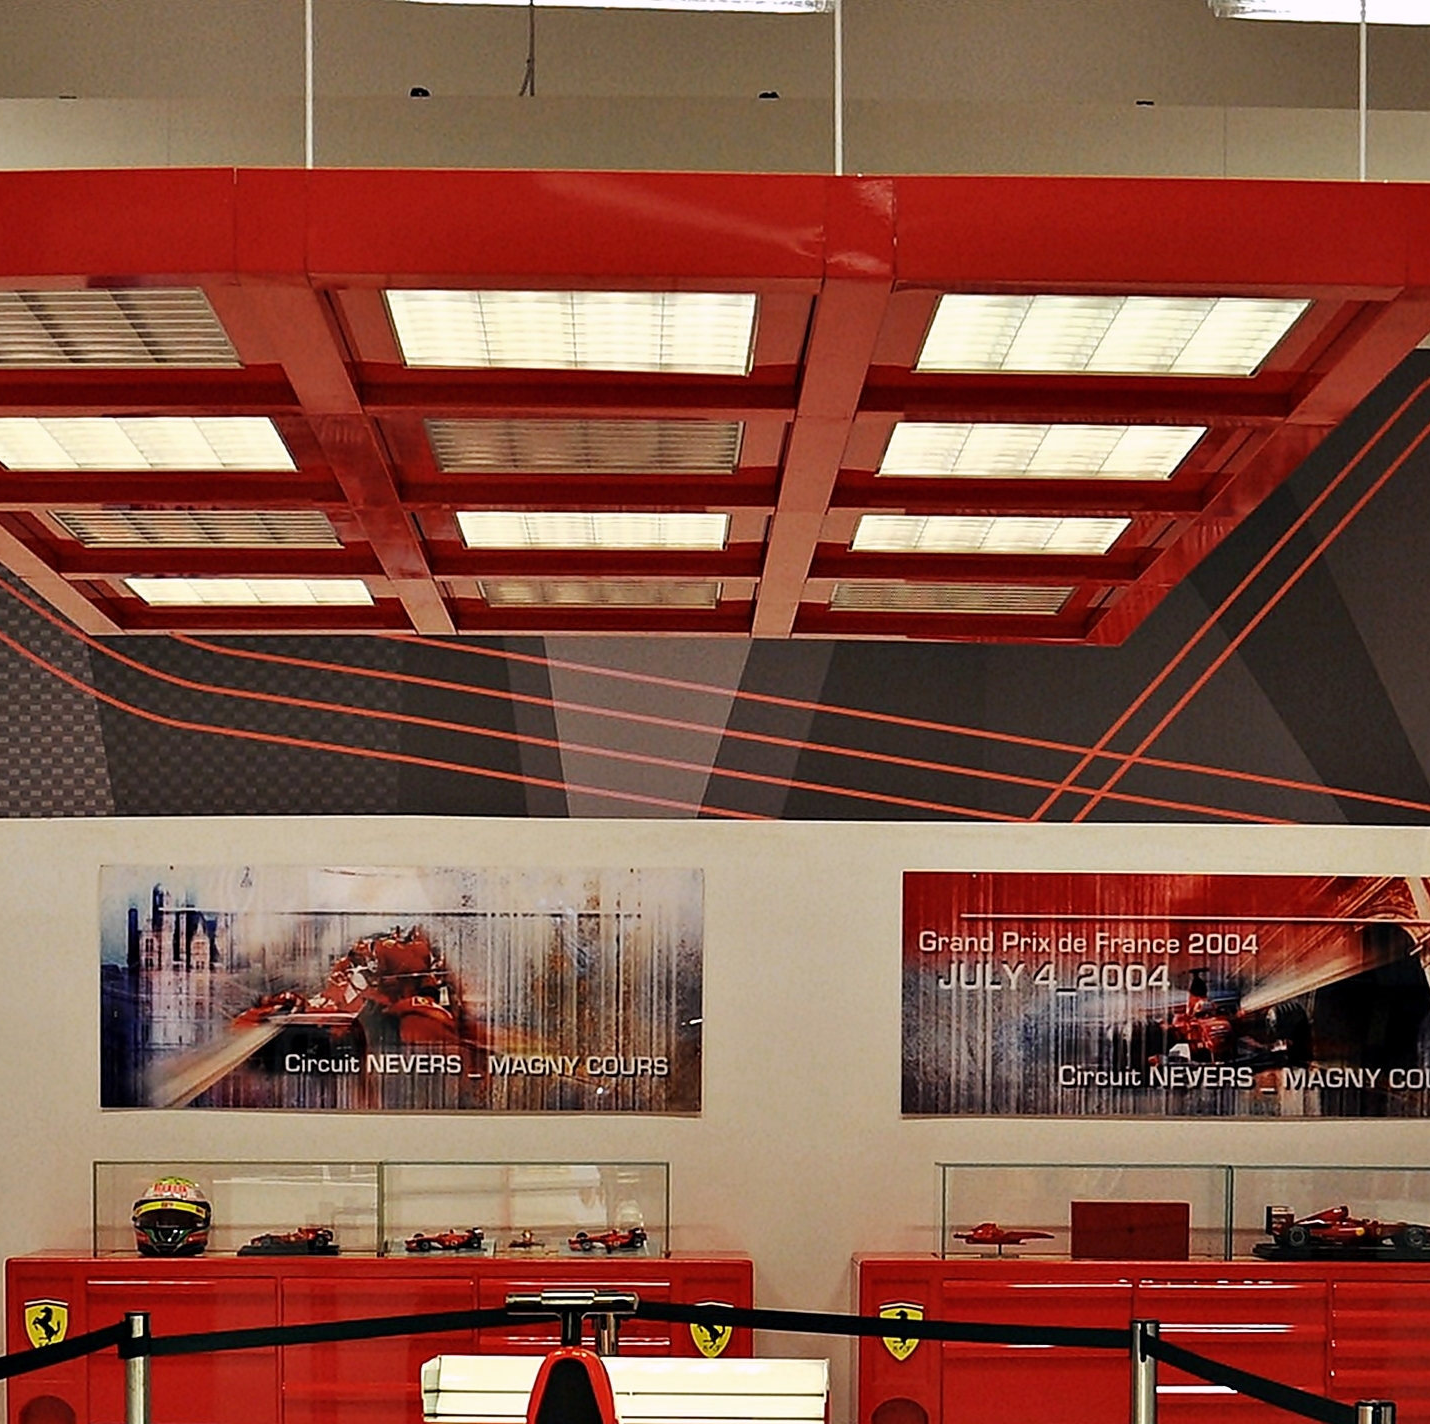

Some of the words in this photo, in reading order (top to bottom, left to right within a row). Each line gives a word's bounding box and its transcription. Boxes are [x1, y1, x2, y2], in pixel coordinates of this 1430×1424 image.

[919, 931, 994, 953] Grand
[1002, 931, 1051, 953] Prix
[1058, 932, 1087, 953] de
[1095, 932, 1180, 954] France
[1188, 933, 1259, 954] 2004
[938, 962, 1025, 990] JULY
[285, 1053, 360, 1073] Circuit
[366, 1055, 461, 1074] NEVERS
[488, 1056, 579, 1076] MAGNY
[586, 1057, 669, 1076] COURS
[1058, 1065, 1141, 1087] Circuit
[1150, 1066, 1253, 1087] NEVERS
[1283, 1068, 1381, 1089] MAGNY
